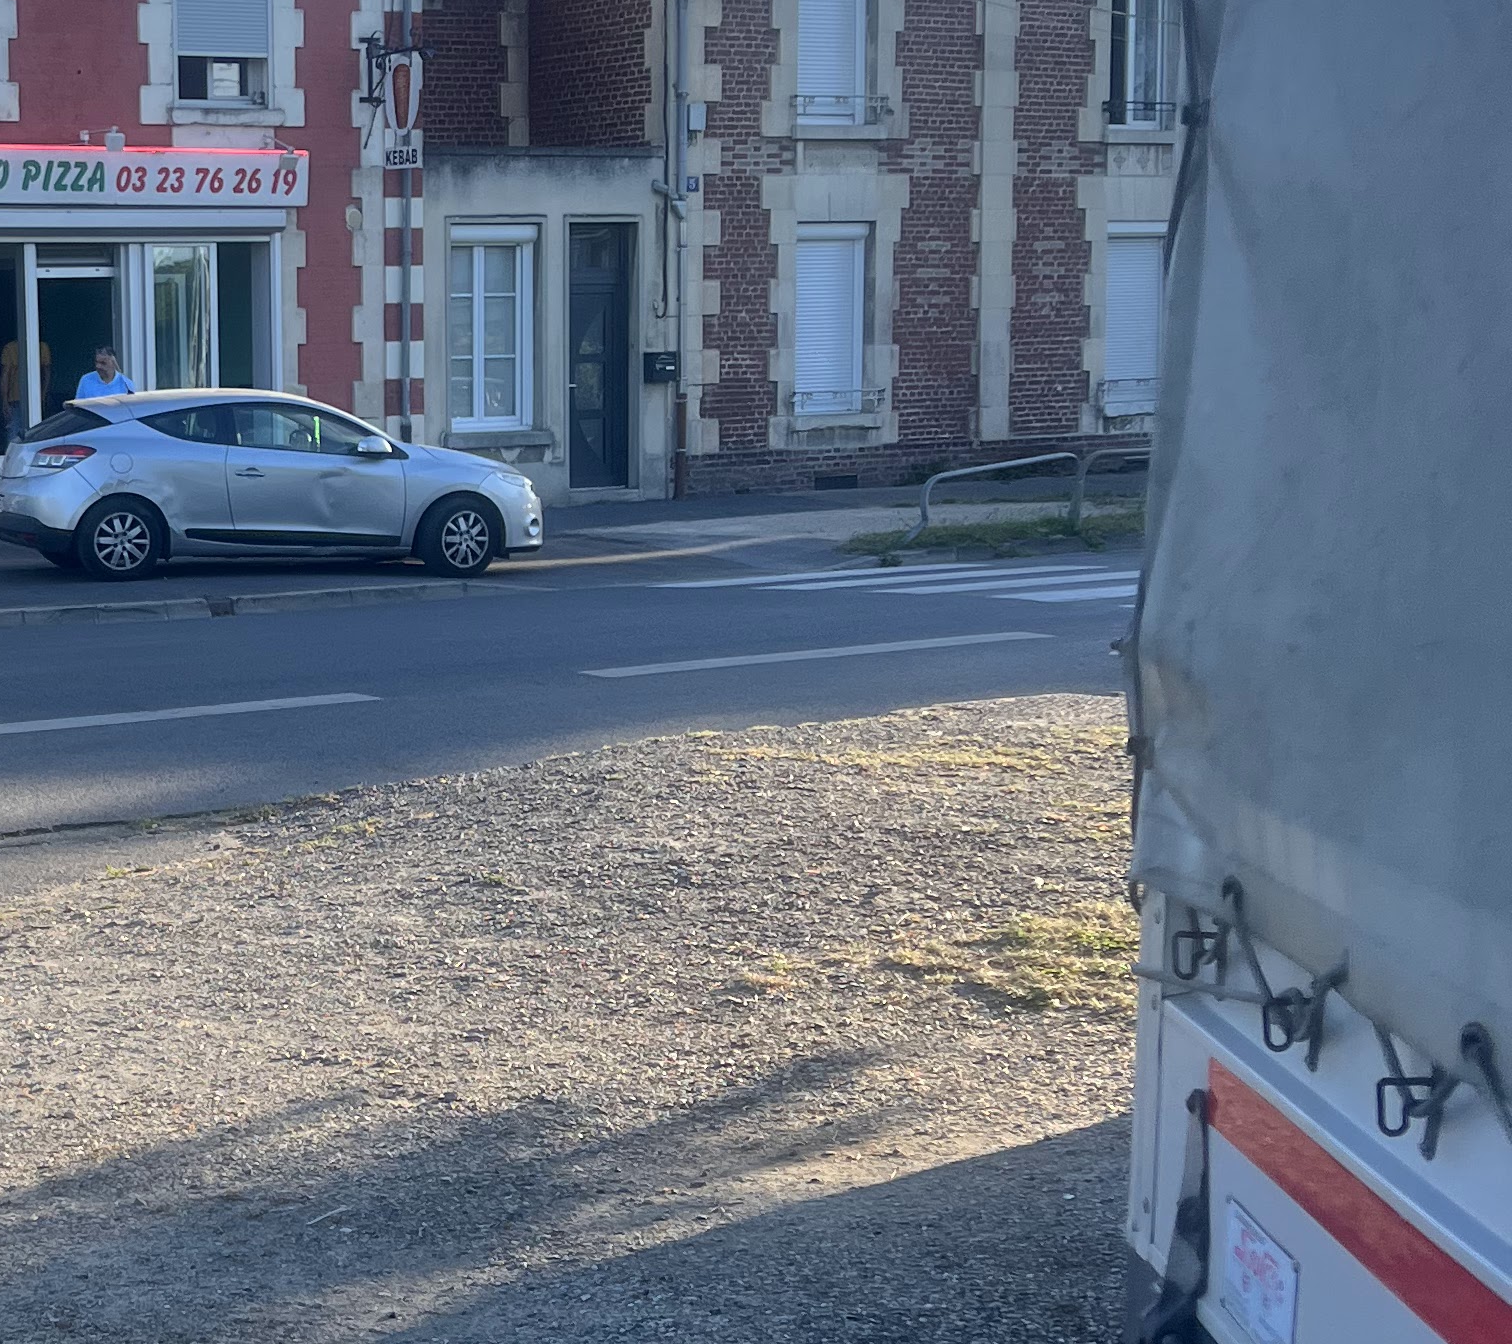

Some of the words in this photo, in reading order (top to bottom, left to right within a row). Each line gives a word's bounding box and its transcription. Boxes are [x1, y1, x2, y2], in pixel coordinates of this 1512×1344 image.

[385, 148, 418, 166] KEBAB
[22, 159, 106, 192] PIZZA
[116, 165, 148, 193] 03
[155, 166, 186, 193] 23
[194, 167, 225, 194] 76
[232, 167, 262, 194] 26
[270, 168, 298, 196] 19
[688, 178, 696, 190] 5
